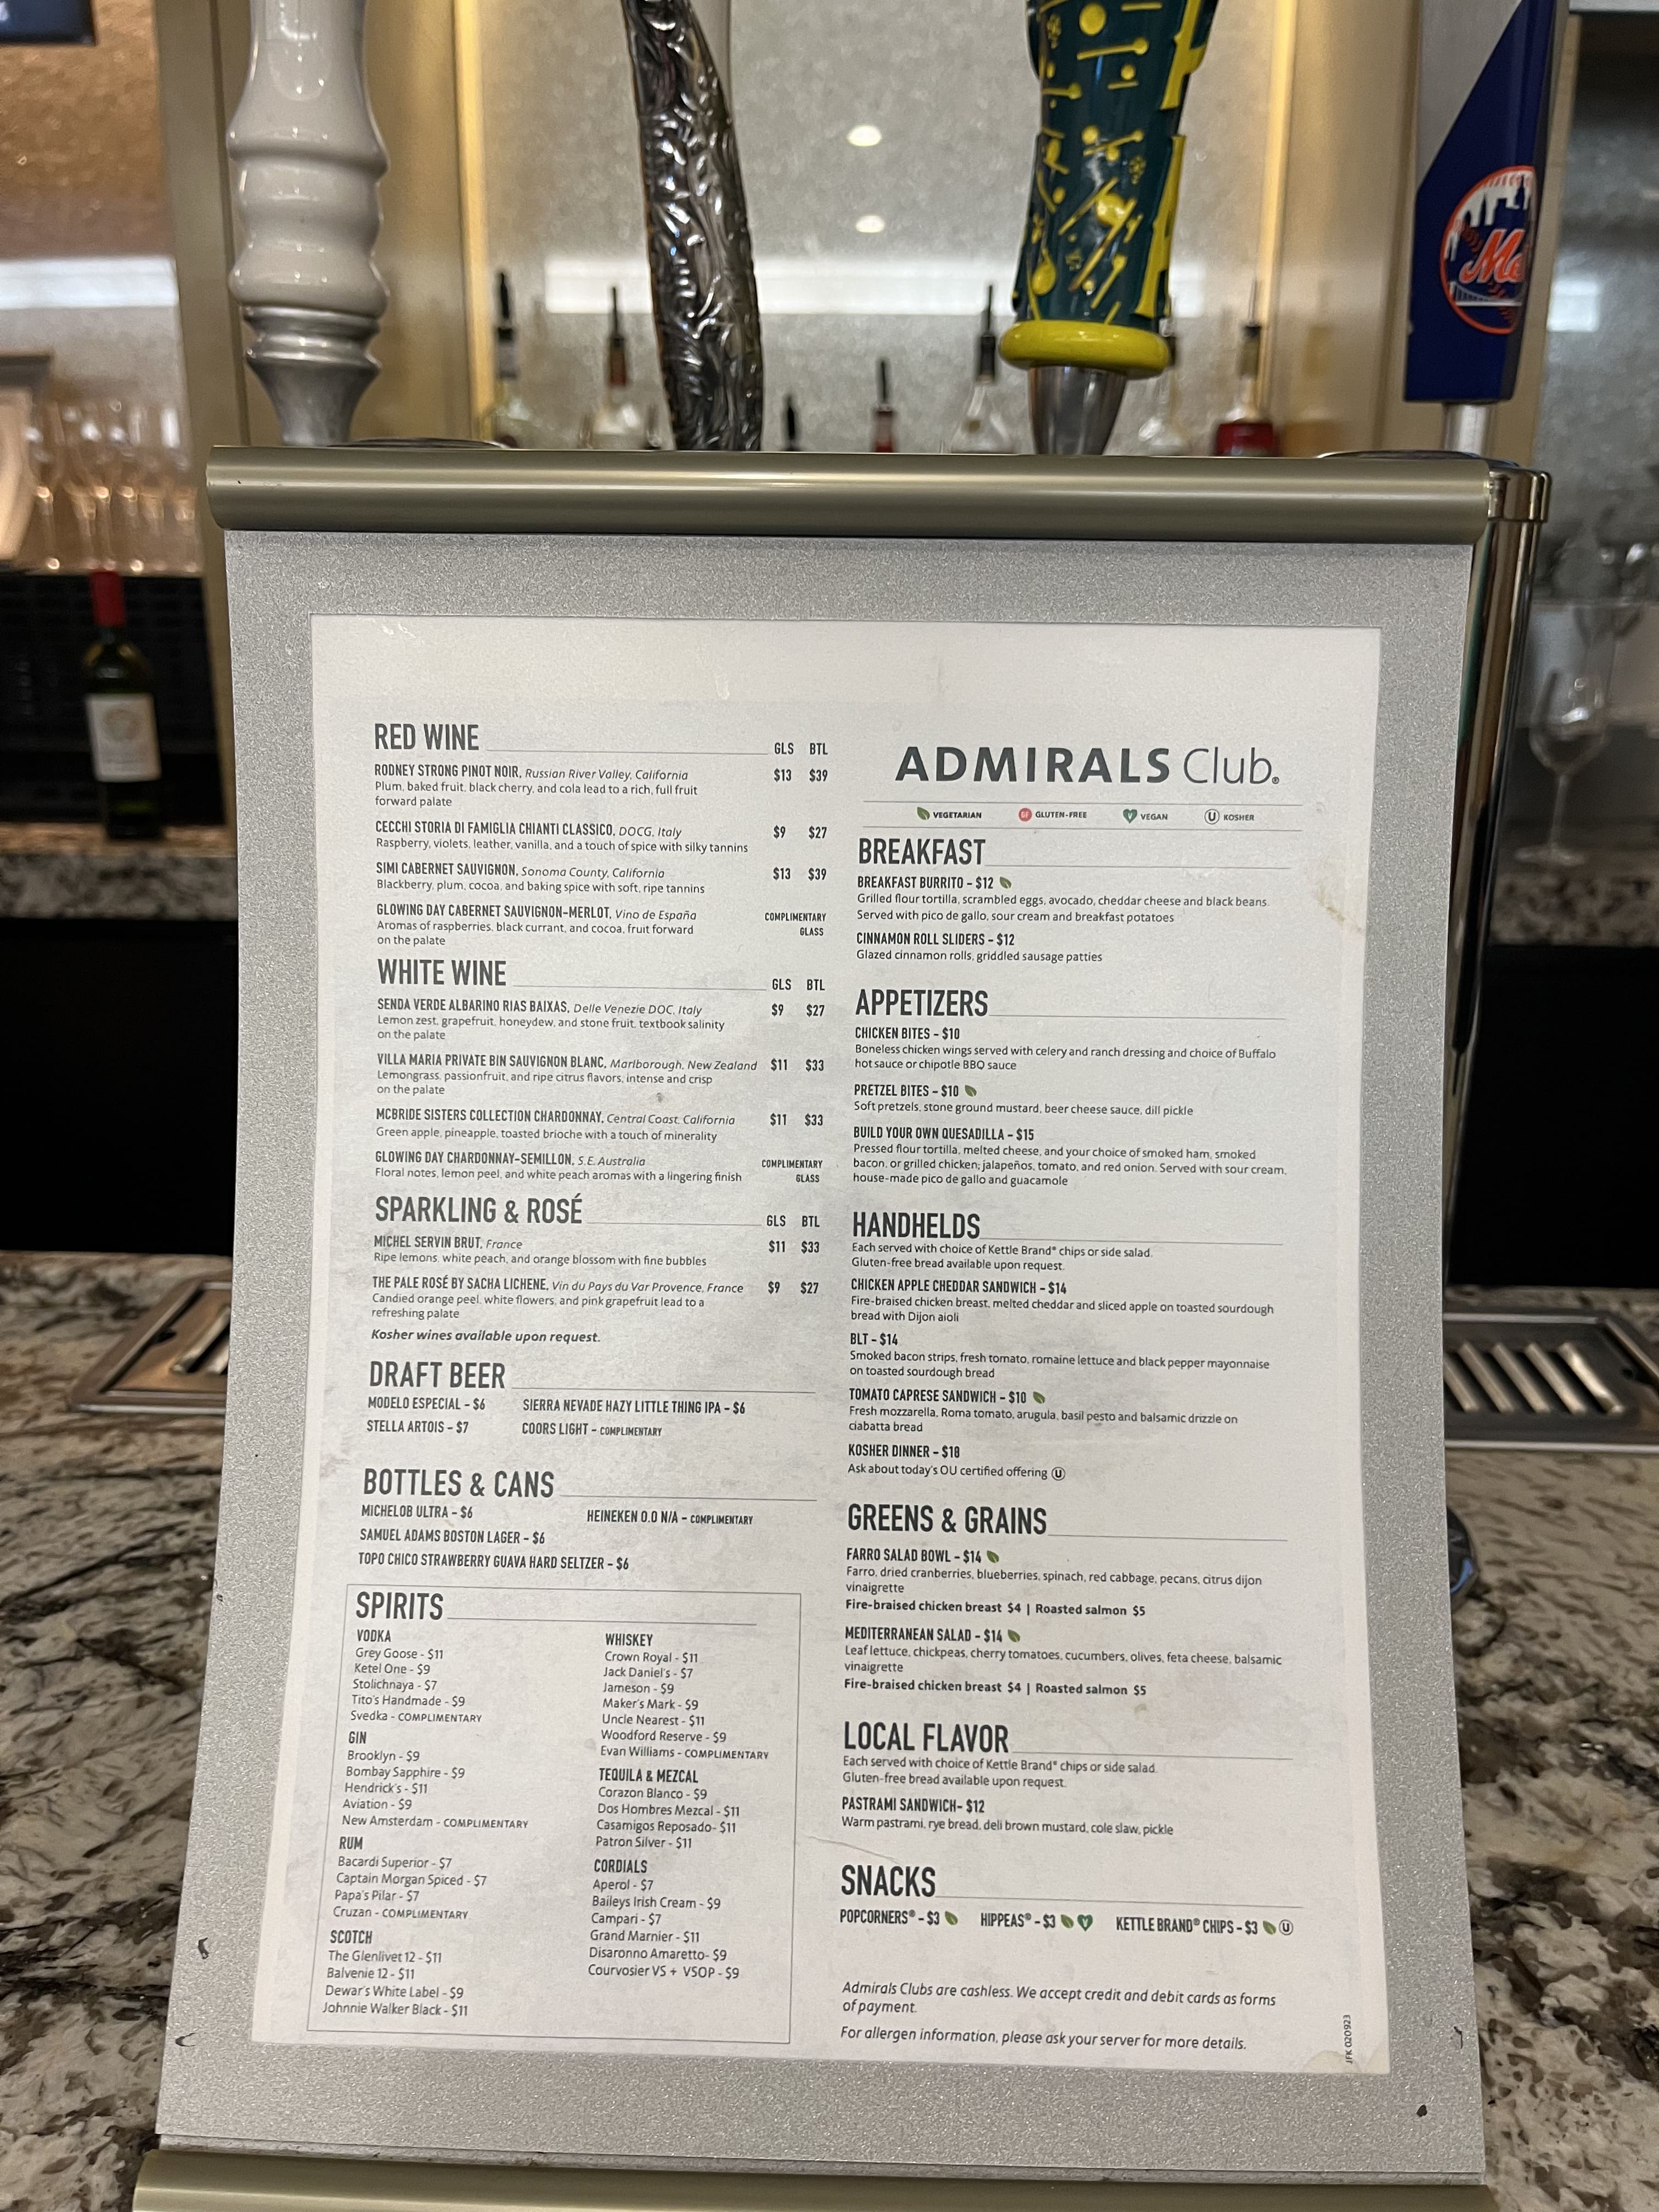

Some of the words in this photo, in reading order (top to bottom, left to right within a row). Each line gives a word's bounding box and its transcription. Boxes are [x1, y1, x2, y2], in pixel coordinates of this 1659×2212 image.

[375, 723, 415, 749] RED
[423, 723, 479, 751] WINE
[775, 742, 793, 754] GLS
[810, 743, 828, 755] BTL
[895, 746, 1169, 783] ADMIRALS
[375, 764, 415, 776] RODNEY
[418, 764, 458, 777] STRONG
[462, 765, 492, 777] PINOT
[494, 765, 521, 778] NOIR,
[526, 769, 565, 778] Russian
[569, 769, 596, 778] River
[599, 769, 631, 782] Valley,
[636, 770, 688, 780] California
[774, 768, 791, 782] $13
[809, 768, 827, 782] $39
[376, 821, 411, 833] CECCHI
[415, 821, 451, 833] STORIA
[455, 821, 464, 833] DI
[468, 822, 516, 834] FAMIGLIA
[520, 822, 558, 834] CHIANTI
[563, 823, 615, 837] CLASSICO,
[619, 827, 654, 837] DOCG,
[658, 827, 682, 840] Italy
[774, 825, 786, 839] $9
[809, 825, 827, 839] $27
[859, 838, 985, 866] BREAKFAST
[765, 912, 826, 922] COMPLIMENTARY
[800, 927, 823, 936] GLASS
[394, 935, 410, 945] the
[414, 936, 445, 947] palate
[857, 949, 891, 960] Glazed
[895, 950, 946, 960] cinnamon
[950, 950, 974, 961] rolls,
[977, 951, 1019, 963] griddled
[1023, 953, 1063, 964] sausage
[1066, 952, 1102, 964] patties
[377, 958, 444, 985] WHITE
[452, 960, 506, 986] WINE
[855, 989, 988, 1016] APPETIZERS
[855, 1027, 898, 1039] CHICKEN
[902, 1028, 930, 1039] BITES
[943, 1027, 960, 1040] $10
[855, 1058, 872, 1068] hot
[919, 1059, 960, 1071] chipotle
[963, 1060, 985, 1070] BBQ
[376, 1196, 496, 1222] SPARKLING
[504, 1200, 519, 1223] &
[527, 1193, 582, 1223] ROSÉ
[853, 1211, 981, 1238] HANDHELDS
[373, 1234, 411, 1247] MICHEL
[415, 1236, 451, 1248] SERVIN
[454, 1236, 482, 1249] BRUT,
[486, 1239, 522, 1249] France
[852, 1257, 912, 1267] Gluten-free
[915, 1258, 944, 1267] bread
[946, 1259, 991, 1269] available
[994, 1262, 1020, 1272] upon
[1023, 1262, 1065, 1273] request.
[371, 1329, 414, 1340] Kosher
[417, 1329, 452, 1340] wines
[455, 1330, 512, 1341] available
[516, 1334, 546, 1344] upon
[550, 1333, 601, 1345] request.
[370, 1361, 443, 1387] DRAFT
[450, 1362, 505, 1389] BEER
[522, 1422, 556, 1435] COORS
[559, 1423, 588, 1435] LIGHT
[600, 1427, 662, 1436] COMPLIMENTARY
[849, 1421, 890, 1431] ciabatta
[894, 1421, 923, 1432] bread
[364, 1468, 462, 1496] BOTTLES
[470, 1472, 485, 1496] &
[494, 1471, 554, 1498] CANS
[848, 1503, 933, 1532] GREENS
[941, 1508, 957, 1532] &
[965, 1506, 1047, 1534] GRAINS
[356, 1591, 443, 1620] SPIRITS
[846, 1599, 916, 1610] Fire-braised
[919, 1600, 962, 1611] chicken
[966, 1601, 1002, 1612] breast
[1008, 1602, 1022, 1613] $4
[1036, 1604, 1082, 1614] Roasted
[1085, 1605, 1127, 1615] salmon
[1133, 1605, 1146, 1617] $5
[357, 1629, 391, 1642] VODKA
[606, 1633, 653, 1646] WHISKEY
[605, 1651, 639, 1662] Crown
[643, 1652, 672, 1665] Royal
[682, 1652, 697, 1664] $11
[353, 1679, 414, 1692] Stolichnaya
[425, 1679, 437, 1691] $7
[348, 1731, 366, 1744] GIN
[844, 1721, 915, 1751] LOCAL
[923, 1723, 1008, 1753] FLAVOR
[599, 1768, 642, 1781] TEQUILA
[646, 1770, 653, 1782] &
[657, 1769, 698, 1783] MEZCAL
[842, 1816, 874, 1827] Warm
[877, 1818, 926, 1830] pastrami,
[928, 1821, 945, 1832] rye
[948, 1818, 981, 1830] bread,
[984, 1819, 1002, 1830] deli
[1005, 1820, 1039, 1831] brown
[1042, 1822, 1088, 1833] mustard,
[1091, 1822, 1113, 1833] cole
[1115, 1822, 1141, 1835] slaw,
[1143, 1824, 1173, 1837] pickle
[339, 1836, 363, 1850] RUM
[594, 1859, 647, 1874] CORDIALS
[842, 1865, 936, 1897] SNACKS
[927, 1910, 940, 1926] $3
[330, 1930, 373, 1944] SCOTCH
[323, 2002, 367, 2013] Johnnie
[370, 2002, 410, 2014] Walker
[412, 2003, 442, 2015] Black
[451, 2004, 467, 2017] $11
[843, 1999, 858, 2012] of
[857, 2002, 917, 2016] payment.
[840, 2026, 862, 2039] For
[865, 2027, 916, 2043] allergen
[920, 2028, 998, 2043] information,
[1001, 2030, 1042, 2046] please
[1046, 2030, 1065, 2044] ask
[1066, 2035, 1098, 2048] your
[1100, 2036, 1141, 2046] server
[1143, 2034, 1162, 2047] for
[1165, 2039, 1199, 2048] more
[1203, 2036, 1246, 2049] details.
[1343, 2015, 1352, 2047] 020923
[1345, 2049, 1353, 2064] JFK
